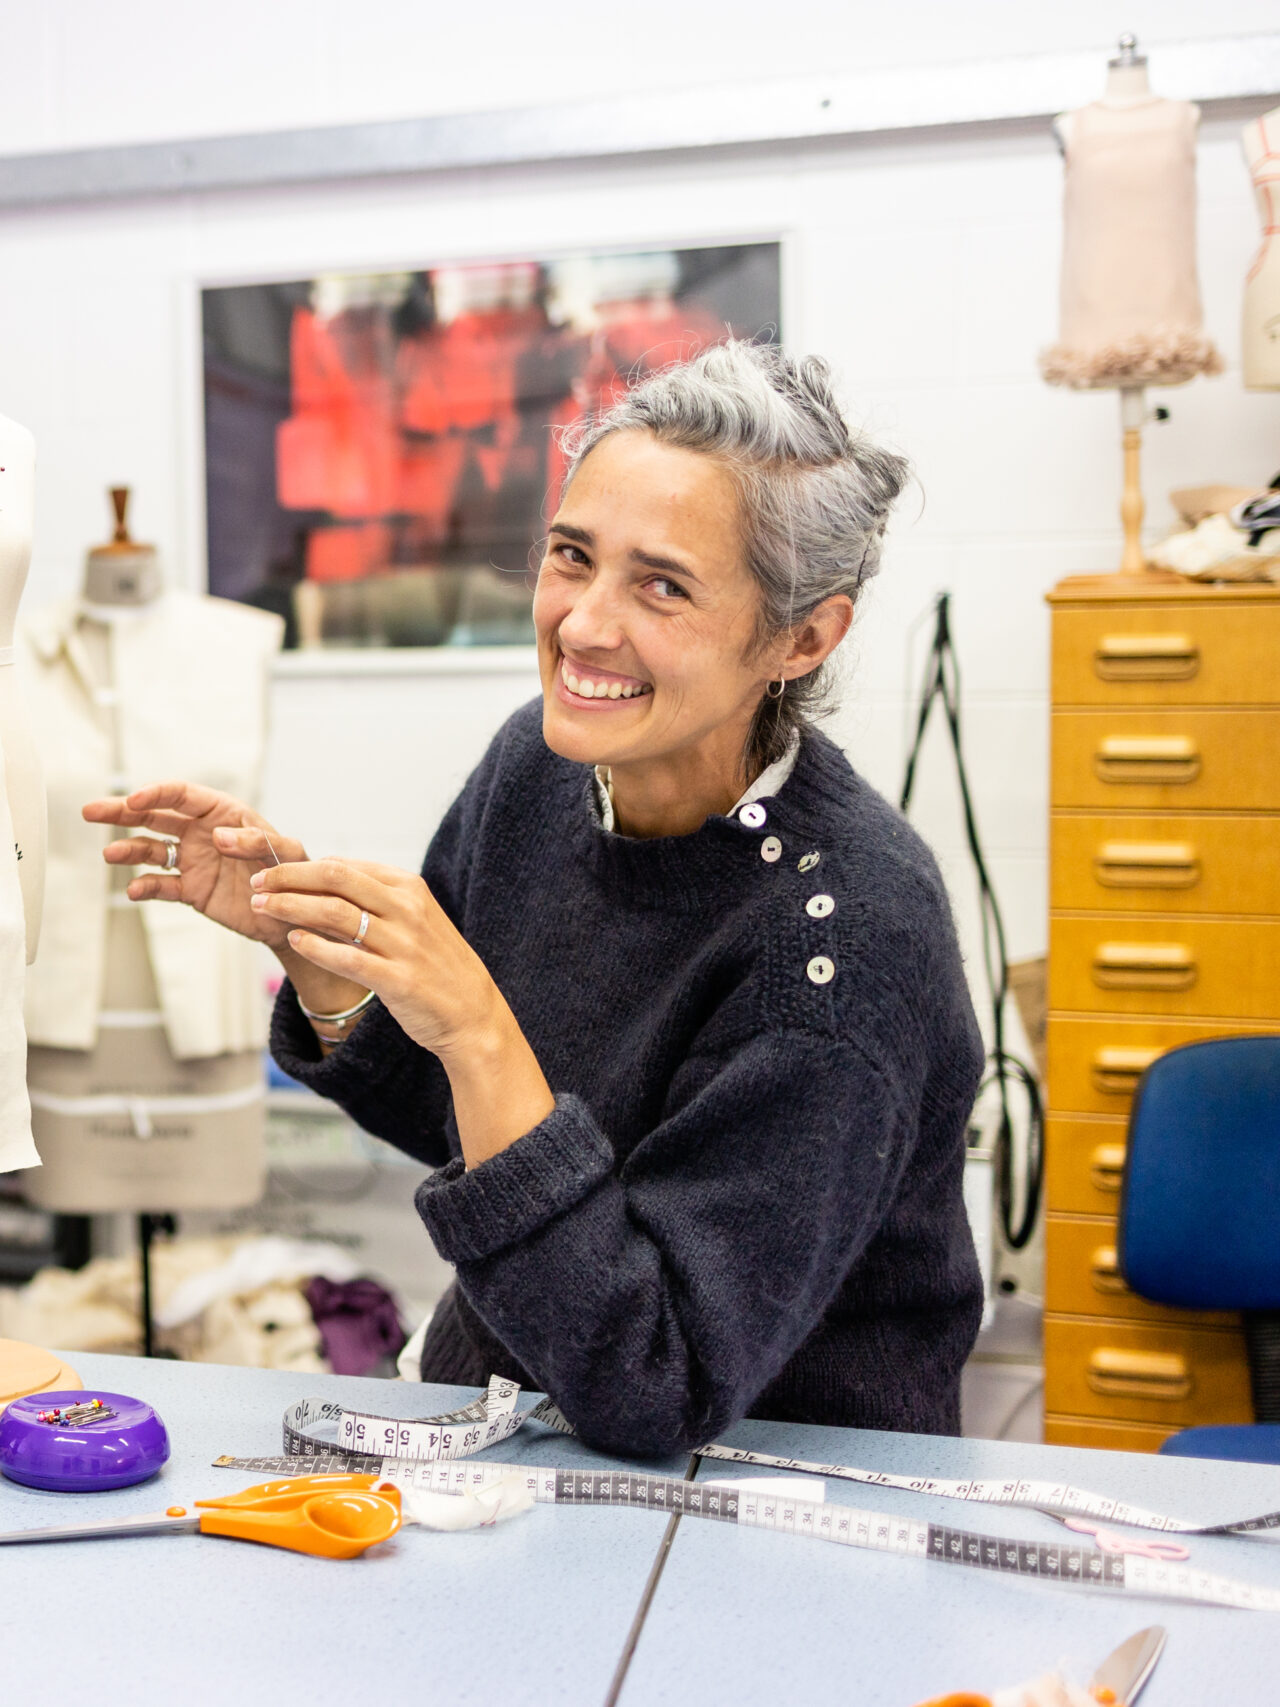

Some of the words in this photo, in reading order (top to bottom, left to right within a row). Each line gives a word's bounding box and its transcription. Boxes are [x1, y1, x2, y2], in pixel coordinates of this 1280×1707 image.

[295, 1403, 309, 1420] 70
[345, 1421, 366, 1439] 56
[505, 1416, 522, 1430] 51
[384, 1428, 410, 1445] 55
[428, 1433, 452, 1448] 54
[463, 1430, 480, 1447] 53
[305, 1444, 313, 1456] 85
[910, 1481, 938, 1489] 40
[956, 1484, 984, 1493] 39
[1002, 1484, 1031, 1493] 38
[1051, 1488, 1080, 1500] 37
[371, 1466, 380, 1475] 10
[387, 1468, 396, 1476] 11
[405, 1468, 414, 1478] 12
[422, 1470, 431, 1480] 13
[440, 1472, 448, 1482] 14
[456, 1473, 464, 1483] 15
[473, 1473, 482, 1484] 16
[528, 1478, 536, 1489] 19
[545, 1480, 554, 1491] 20
[563, 1482, 573, 1493] 21
[581, 1482, 592, 1494] 22
[600, 1483, 610, 1494] 23
[618, 1483, 629, 1495] 24
[636, 1485, 647, 1498] 25
[654, 1488, 665, 1500] 26
[673, 1491, 683, 1503] 27
[690, 1494, 701, 1506] 28
[709, 1497, 719, 1509] 29
[727, 1500, 737, 1512] 30
[745, 1504, 756, 1516] 31
[764, 1506, 774, 1518] 32
[783, 1509, 793, 1521] 33
[802, 1512, 812, 1525] 34
[820, 1516, 830, 1528] 35
[838, 1519, 848, 1532] 36
[857, 1522, 867, 1535] 37
[877, 1526, 888, 1538] 38
[897, 1529, 908, 1542] 39
[917, 1533, 926, 1545] 40
[934, 1537, 944, 1550] 41
[951, 1540, 961, 1553] 42
[968, 1544, 979, 1557] 43
[986, 1548, 997, 1560] 44
[1006, 1551, 1017, 1564] 45
[1046, 1555, 1058, 1569] 47
[1089, 1559, 1102, 1573] 49
[1111, 1562, 1124, 1576] 50
